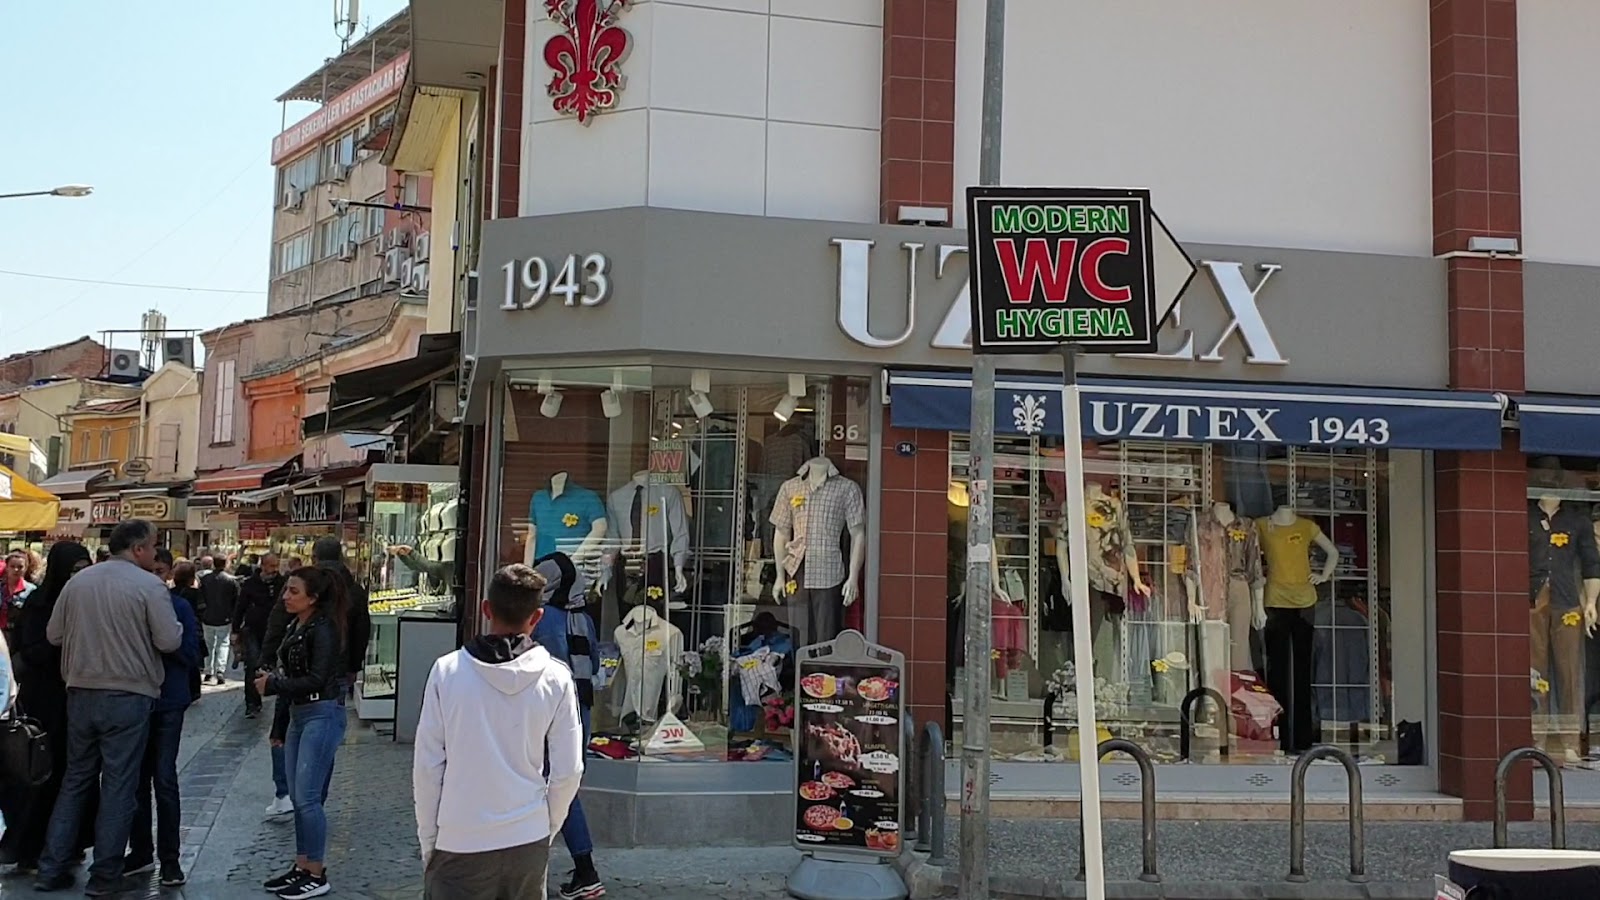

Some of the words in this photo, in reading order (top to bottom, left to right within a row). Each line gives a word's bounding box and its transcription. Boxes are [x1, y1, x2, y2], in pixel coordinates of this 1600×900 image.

[992, 205, 1130, 233] MODERN
[500, 251, 612, 311] 1943
[993, 237, 1132, 304] WC
[996, 308, 1134, 338] HYGIENA
[833, 424, 859, 441] 36
[1089, 400, 1282, 442] UZTEX
[1309, 416, 1390, 445] 1943
[901, 443, 911, 453] 36
[290, 493, 327, 522] SAFIRA
